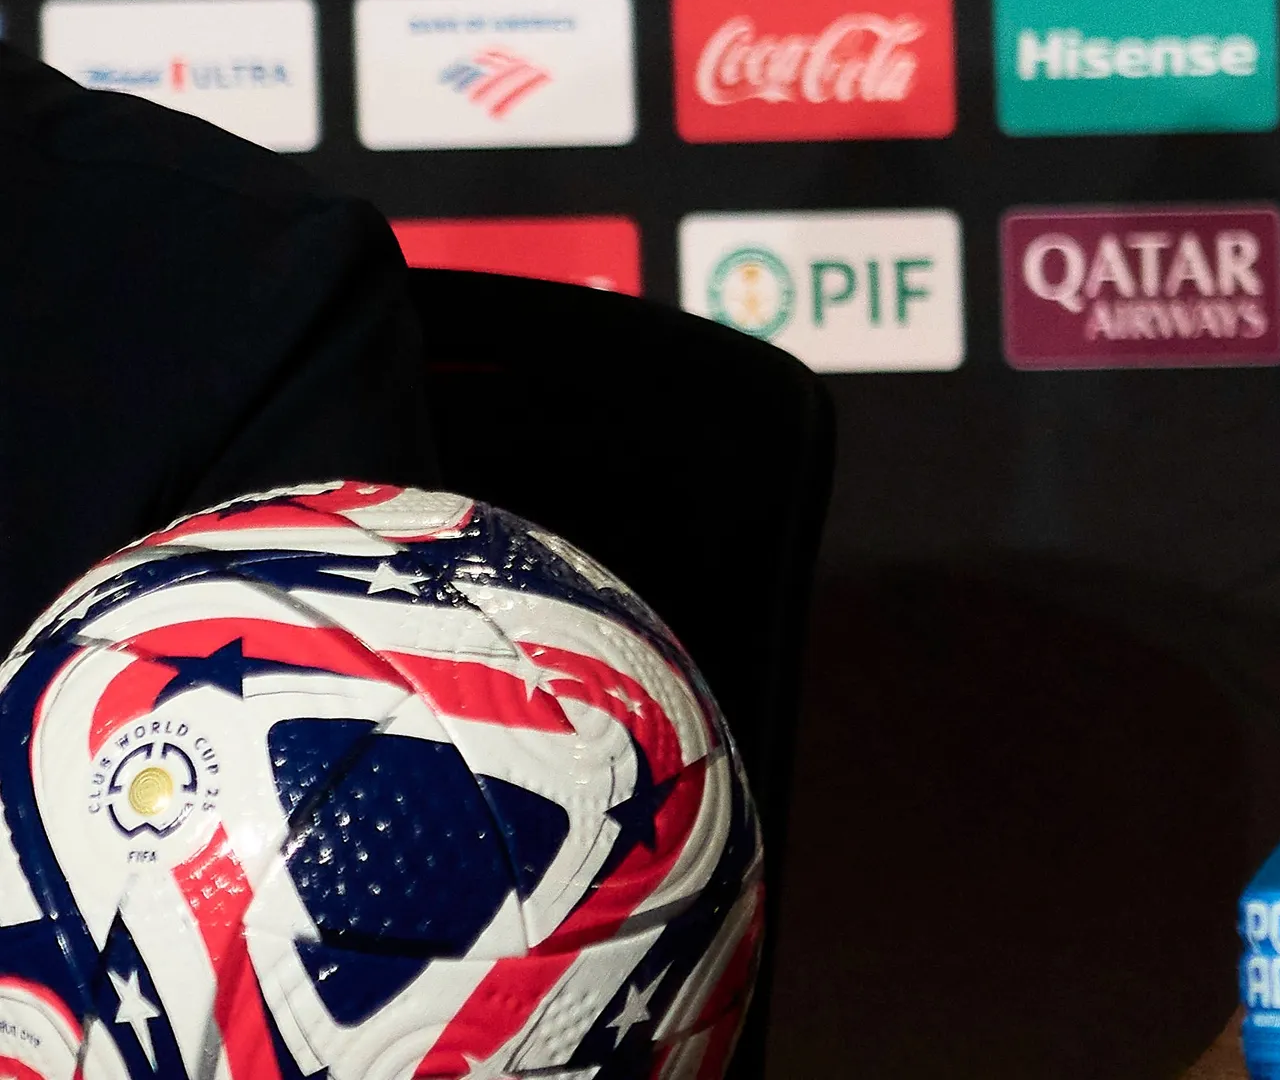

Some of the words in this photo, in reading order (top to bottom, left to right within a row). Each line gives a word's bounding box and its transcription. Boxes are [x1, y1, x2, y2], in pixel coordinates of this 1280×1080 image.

[1017, 29, 1258, 80] Hisense
[810, 257, 933, 325] PIF
[1023, 234, 1260, 312] QATAR
[88, 757, 113, 814] CLUB
[115, 721, 190, 751] WORLD
[194, 737, 220, 776] CUP
[127, 850, 158, 864] FIFA
